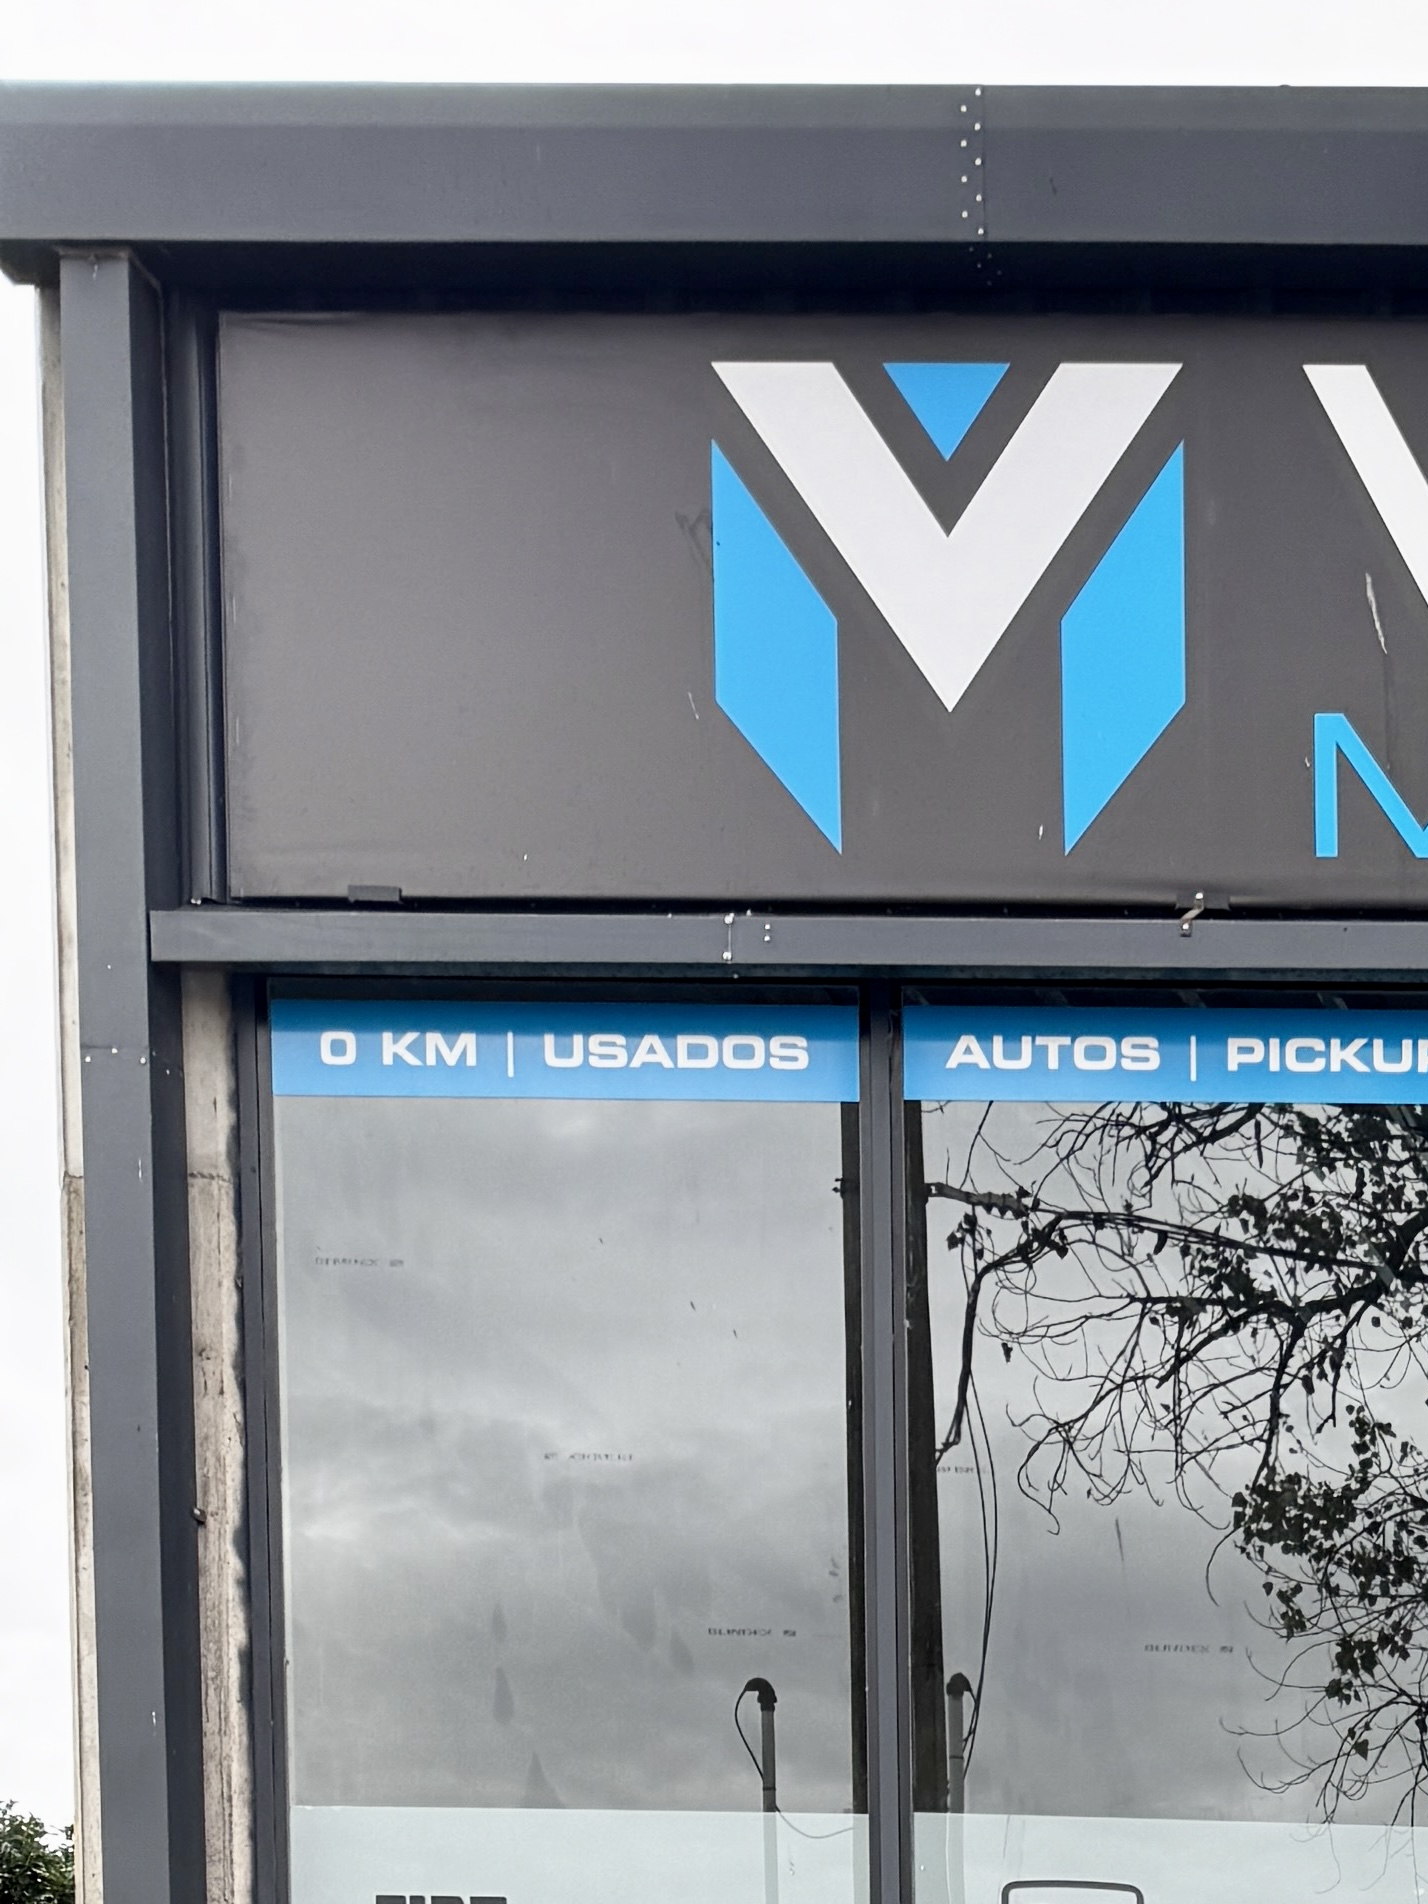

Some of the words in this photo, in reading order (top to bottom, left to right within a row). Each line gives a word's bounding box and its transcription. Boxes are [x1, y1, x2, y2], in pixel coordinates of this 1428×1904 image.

[319, 1032, 357, 1066] 0
[381, 1033, 477, 1068] KM
[543, 1035, 811, 1070] USADOS
[946, 1036, 1161, 1076] AUTOS
